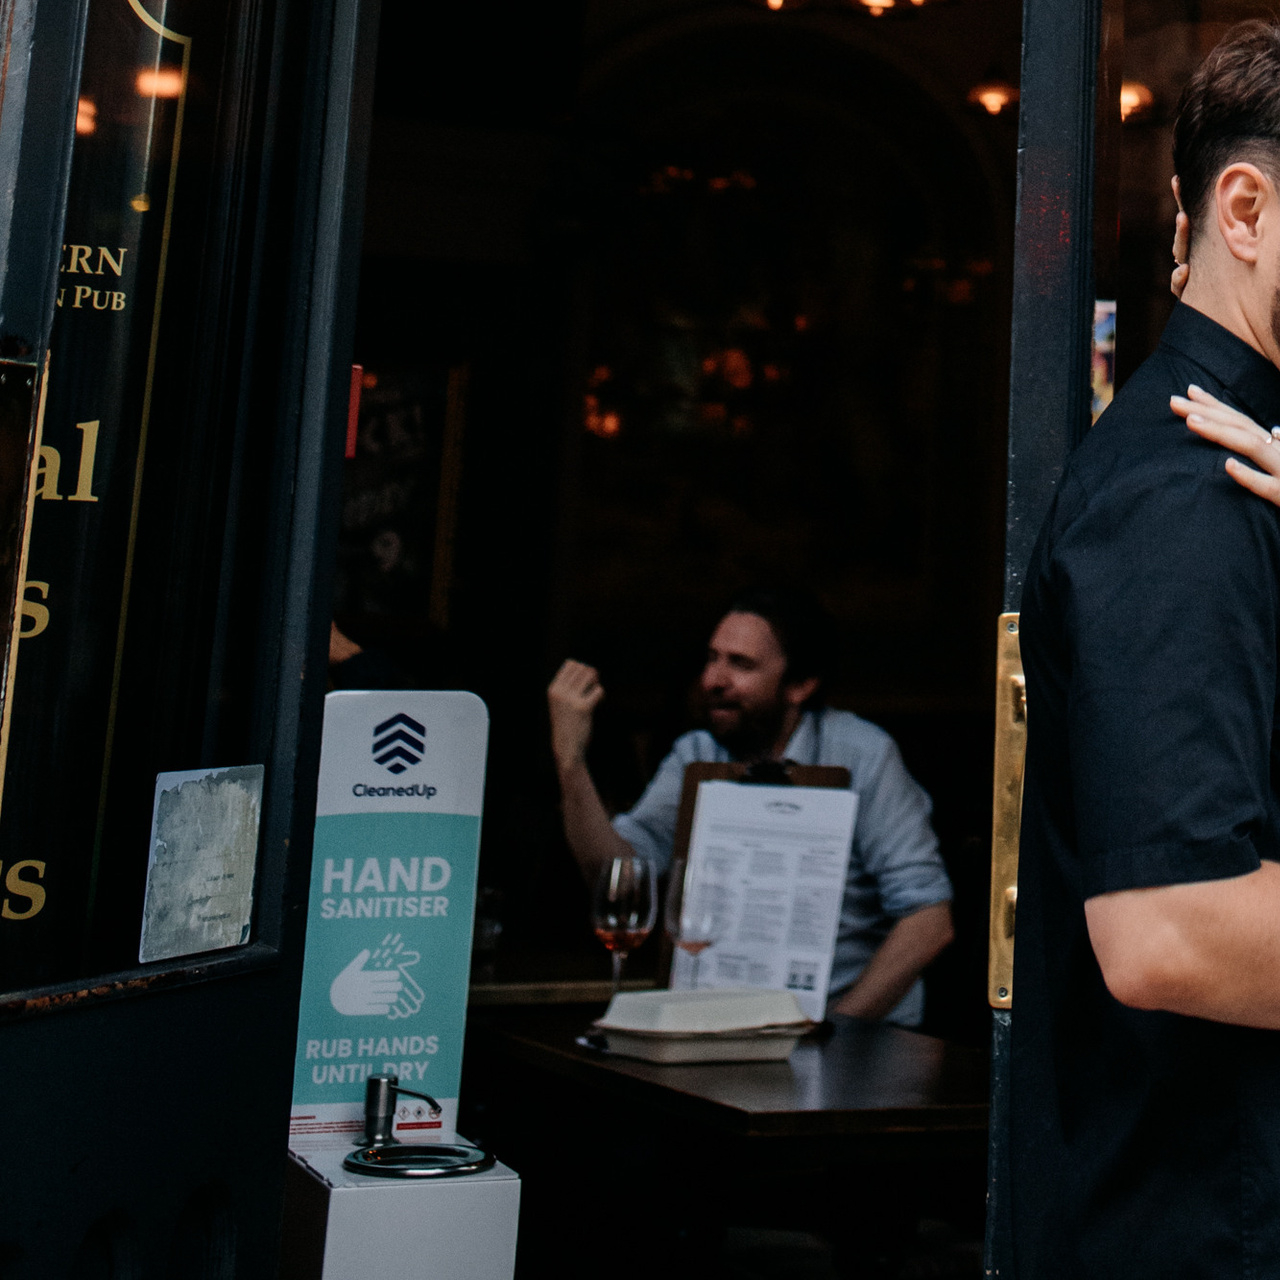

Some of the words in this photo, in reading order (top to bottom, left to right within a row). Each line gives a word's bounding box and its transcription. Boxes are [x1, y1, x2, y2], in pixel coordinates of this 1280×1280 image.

[60, 244, 128, 277] RN
[72, 285, 126, 311] PUB
[352, 783, 438, 800] CleanedUp
[322, 856, 452, 894] HAND
[320, 895, 450, 920] SANITISER
[305, 1038, 352, 1060] RUB
[357, 1035, 439, 1058] HANDS
